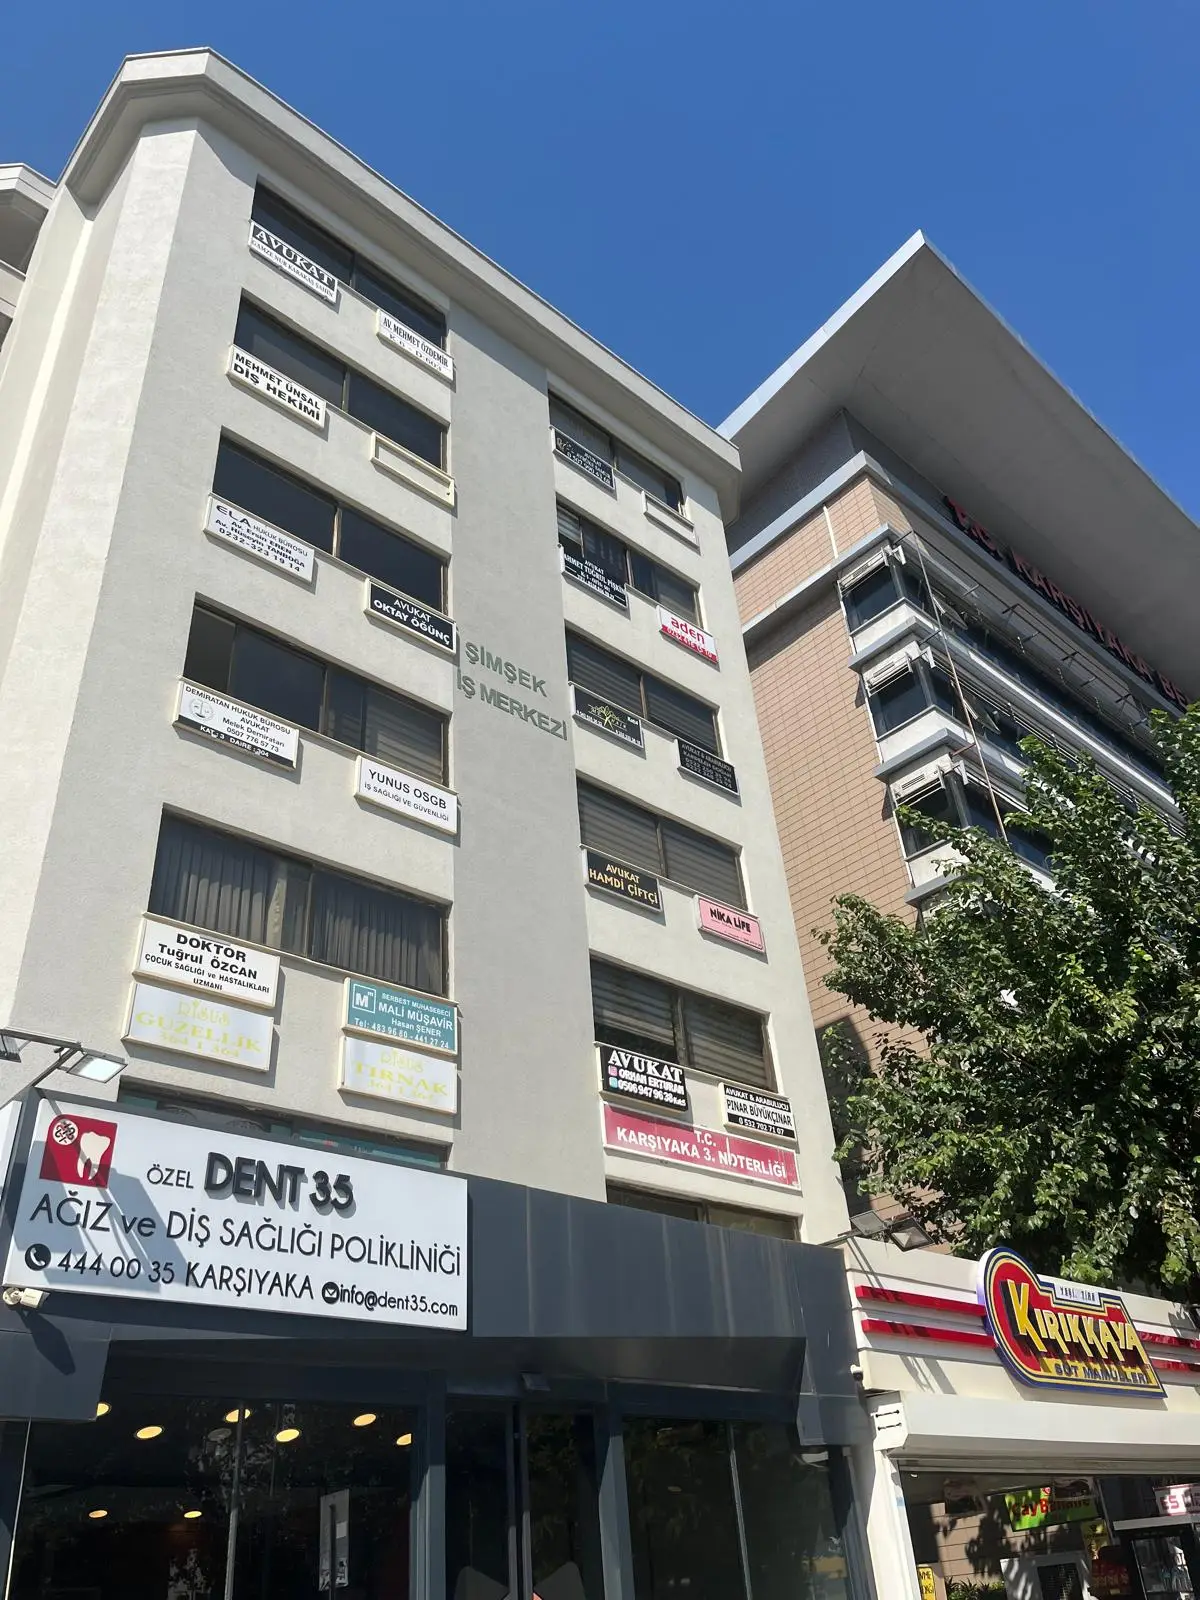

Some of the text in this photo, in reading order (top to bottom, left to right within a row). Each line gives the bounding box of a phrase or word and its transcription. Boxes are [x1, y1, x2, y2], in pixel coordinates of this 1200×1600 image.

[256, 231, 333, 286] AVUKAT
[383, 318, 448, 368] AV. MEHMET ÖZDEMİR
[234, 363, 320, 420] DİŞ HEKİMİ
[236, 353, 320, 410] MEHMET ÜNSAL
[216, 505, 251, 528] ELA
[254, 525, 276, 541] HUKUK
[216, 520, 228, 529] Av.
[246, 529, 267, 542] Ersin
[270, 540, 292, 555] EREN
[274, 555, 285, 564] 19
[289, 562, 300, 572] 14
[374, 600, 450, 646] OKTAY ÖĞÜNÇ
[394, 599, 432, 622] AVUKAT
[671, 617, 704, 644] aden
[232, 706, 258, 721] HUKUK
[240, 717, 270, 733] AVUKAT
[480, 683, 568, 740] MERKEZİ
[222, 717, 285, 748] Melek Demiratan
[226, 727, 244, 738] 0507
[260, 740, 268, 748] 57
[270, 744, 279, 752] 73
[368, 769, 446, 809] YUNUS OSGB
[402, 798, 412, 807] VE
[589, 868, 658, 904] HAMDİ ÇİFTÇİ
[606, 864, 640, 884] AVUKAT
[710, 908, 732, 925] NİKA
[733, 917, 751, 932] LİFE
[158, 944, 258, 980] Tuğrul ÖZCAN
[176, 934, 246, 962] DOKTOR
[145, 954, 172, 968] ÇOCUK
[218, 974, 270, 994] HASTALIKLARI
[193, 978, 222, 990] UZMANI
[382, 993, 410, 1006] SERBEST
[378, 1002, 452, 1030] MALİ MÜŞAVİR
[392, 1018, 442, 1038] Hasan ŞENER
[354, 1018, 370, 1028] Tel:
[372, 1022, 386, 1032] 483
[430, 1038, 438, 1046] 27
[440, 1040, 449, 1048] 24
[608, 1050, 682, 1084] AVUKAT
[618, 1068, 684, 1095] ORHAN ERTURAN
[618, 1080, 638, 1094] 0506
[638, 1085, 652, 1098] 947
[652, 1089, 664, 1100] 96
[726, 1088, 748, 1100] AVUKAT
[756, 1096, 789, 1110] ARABULUCU
[727, 1100, 792, 1126] PINAR BÜYÜKÇINAR
[694, 1130, 716, 1146] T.C.
[744, 1118, 756, 1128] 532
[756, 1122, 768, 1130] 702
[776, 1128, 784, 1136] 07
[616, 1126, 787, 1178] KARŞIYAKA 3. NOTERLİĞİ
[146, 1152, 354, 1211] ÖZEL DENT 35
[29, 1190, 460, 1276] AĞIZ ve DİŞ SAĞLIĞI POLİKLİNİĞİ
[58, 1248, 458, 1316] 444 00 35 KARŞIYAKA info@dent35.com
[1008, 1278, 1150, 1364] KIRIKKAYA
